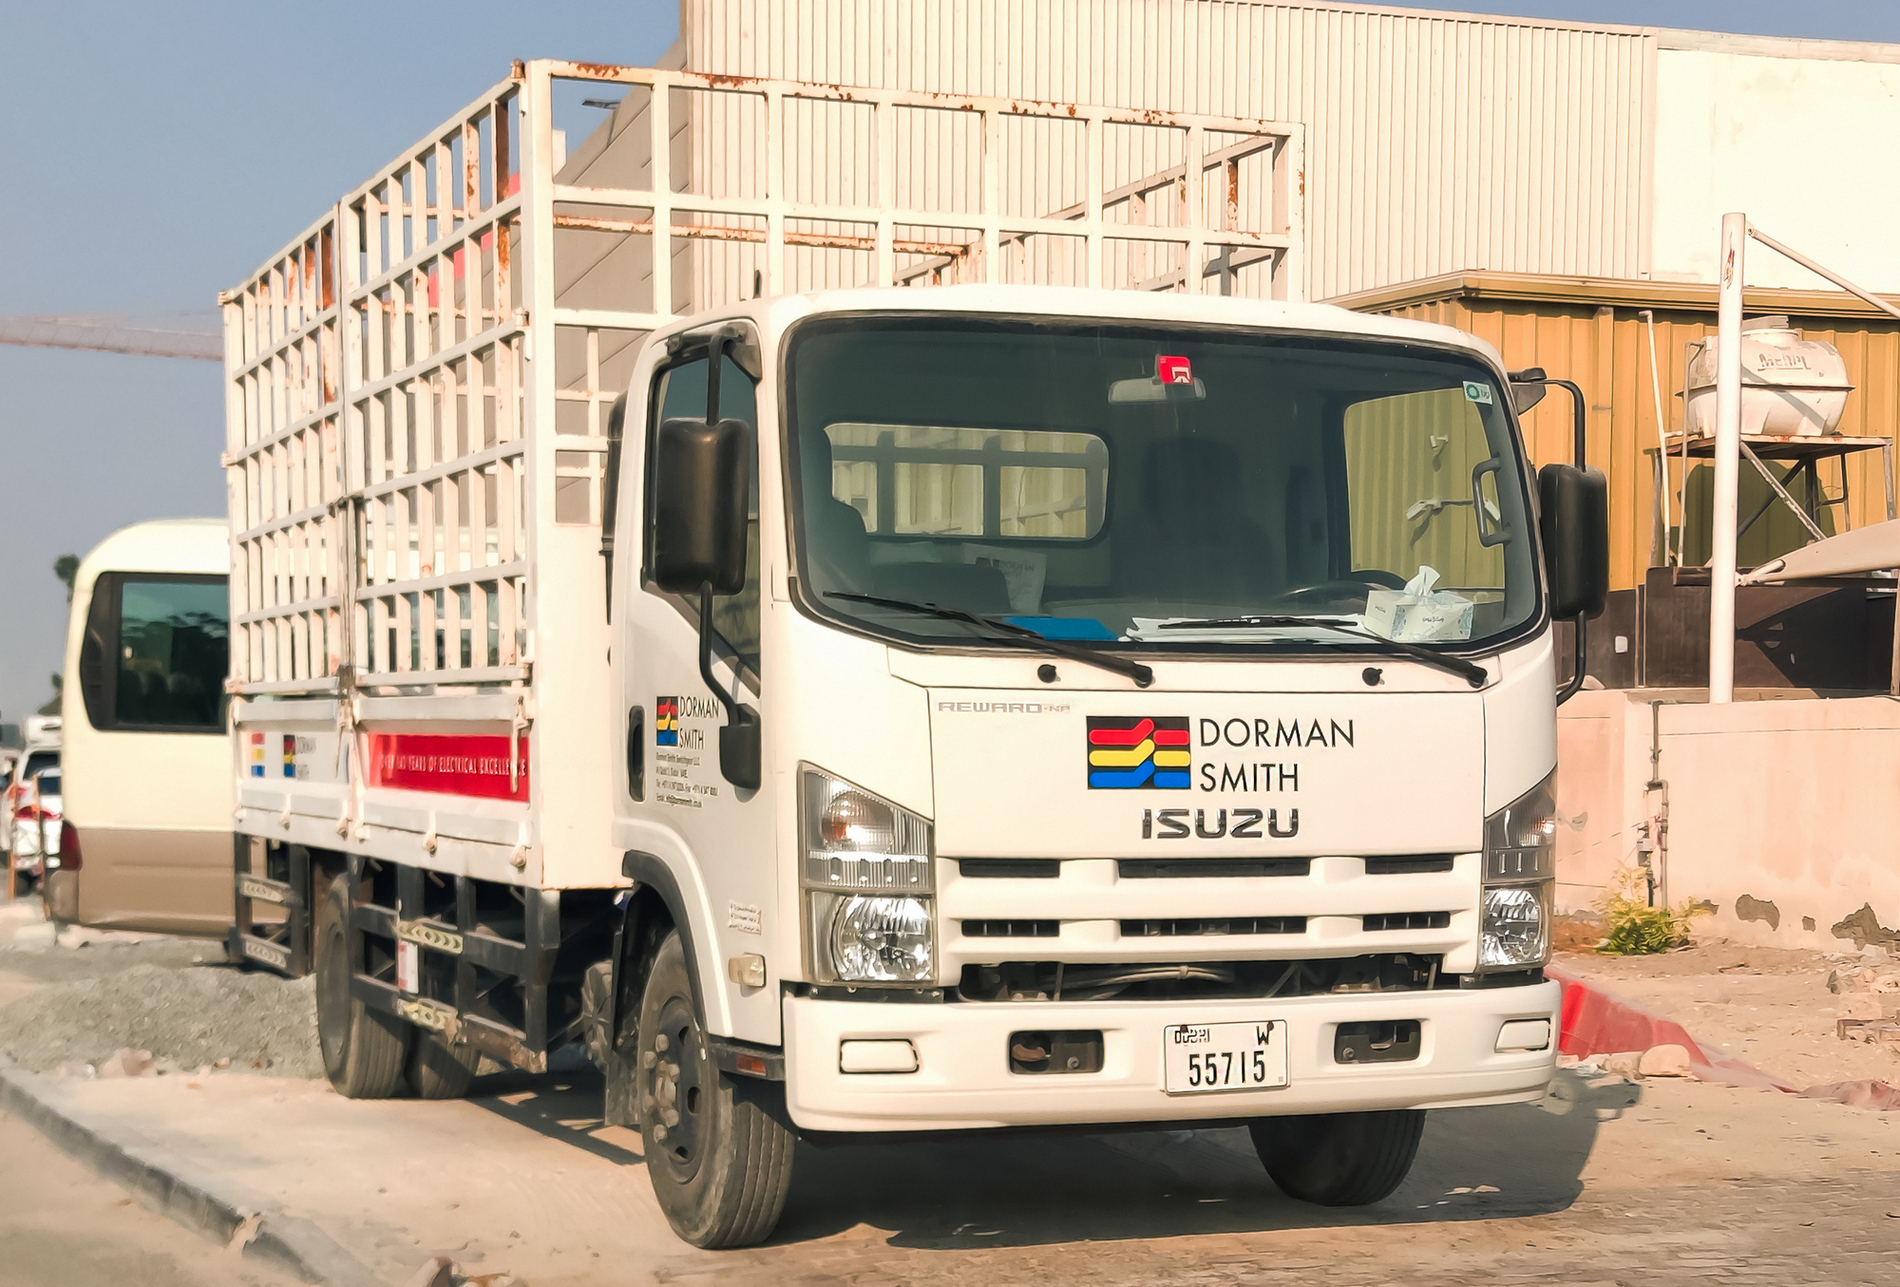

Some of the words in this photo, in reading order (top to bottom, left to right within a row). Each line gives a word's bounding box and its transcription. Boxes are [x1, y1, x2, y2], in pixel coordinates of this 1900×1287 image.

[679, 695, 719, 718] DORMAN
[679, 728, 704, 750] SMITH
[1200, 718, 1354, 748] DORMAN
[479, 757, 527, 777] EXCELLEE
[1200, 763, 1299, 792] SMITH
[1141, 808, 1299, 839] ISUZU
[1256, 1025, 1271, 1045] W
[1189, 1050, 1265, 1086] 55715
